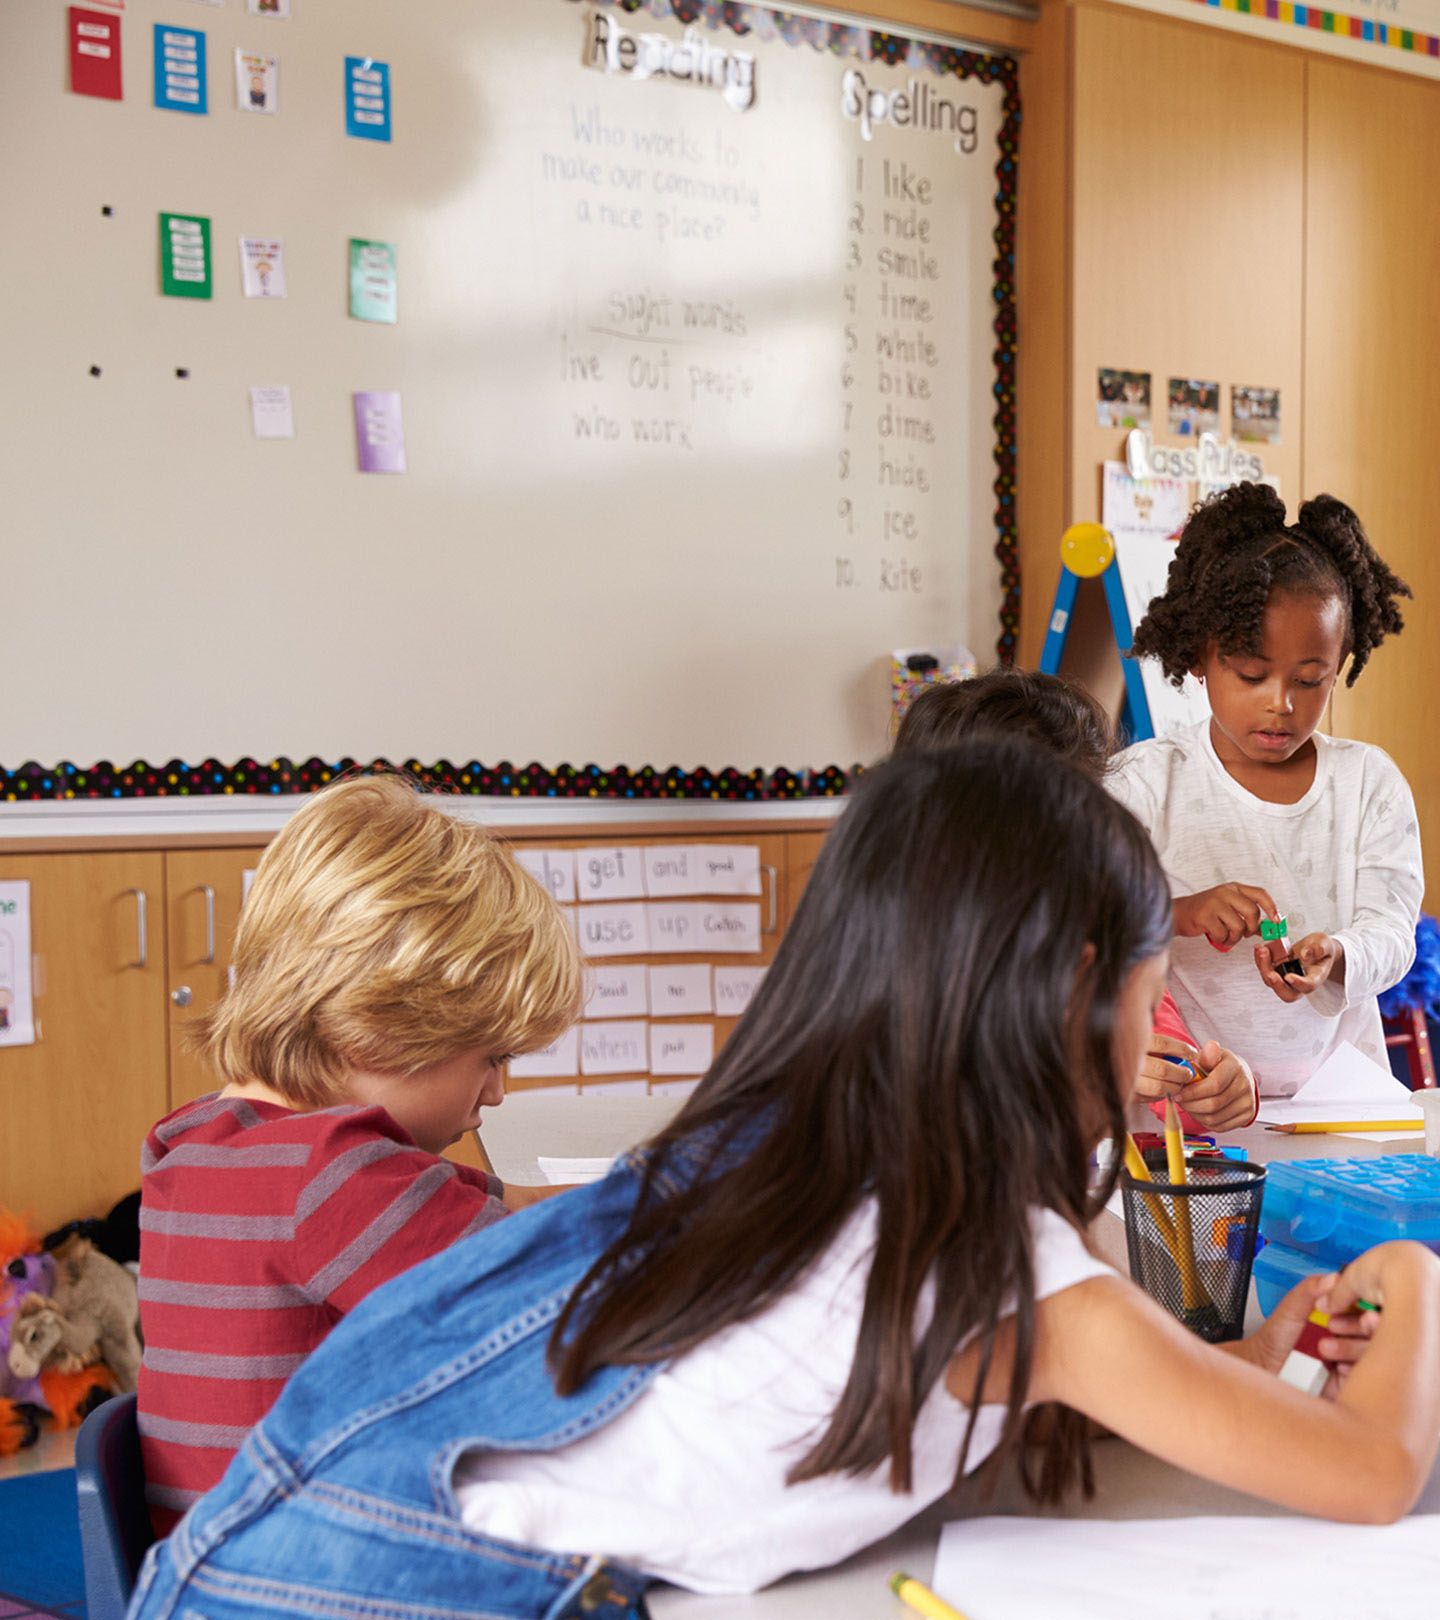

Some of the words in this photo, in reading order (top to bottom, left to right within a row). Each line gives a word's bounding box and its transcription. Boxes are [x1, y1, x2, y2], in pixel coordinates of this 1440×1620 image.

[594, 13, 757, 111] Reading
[569, 103, 626, 147] Who
[846, 71, 978, 154] Spelling
[542, 152, 602, 187] make
[607, 163, 643, 190] our
[883, 159, 932, 205] like
[883, 208, 931, 244] ride
[877, 247, 939, 281] smile
[878, 279, 934, 323] time
[628, 348, 671, 391] out
[878, 357, 932, 400] bike
[877, 402, 936, 445] dime
[878, 443, 930, 493] hide
[1201, 436, 1264, 480] Rules
[883, 502, 920, 541] ice
[879, 557, 922, 592] kite
[588, 851, 624, 890] get
[653, 852, 688, 878] and
[585, 920, 634, 941] use
[659, 916, 690, 938] up
